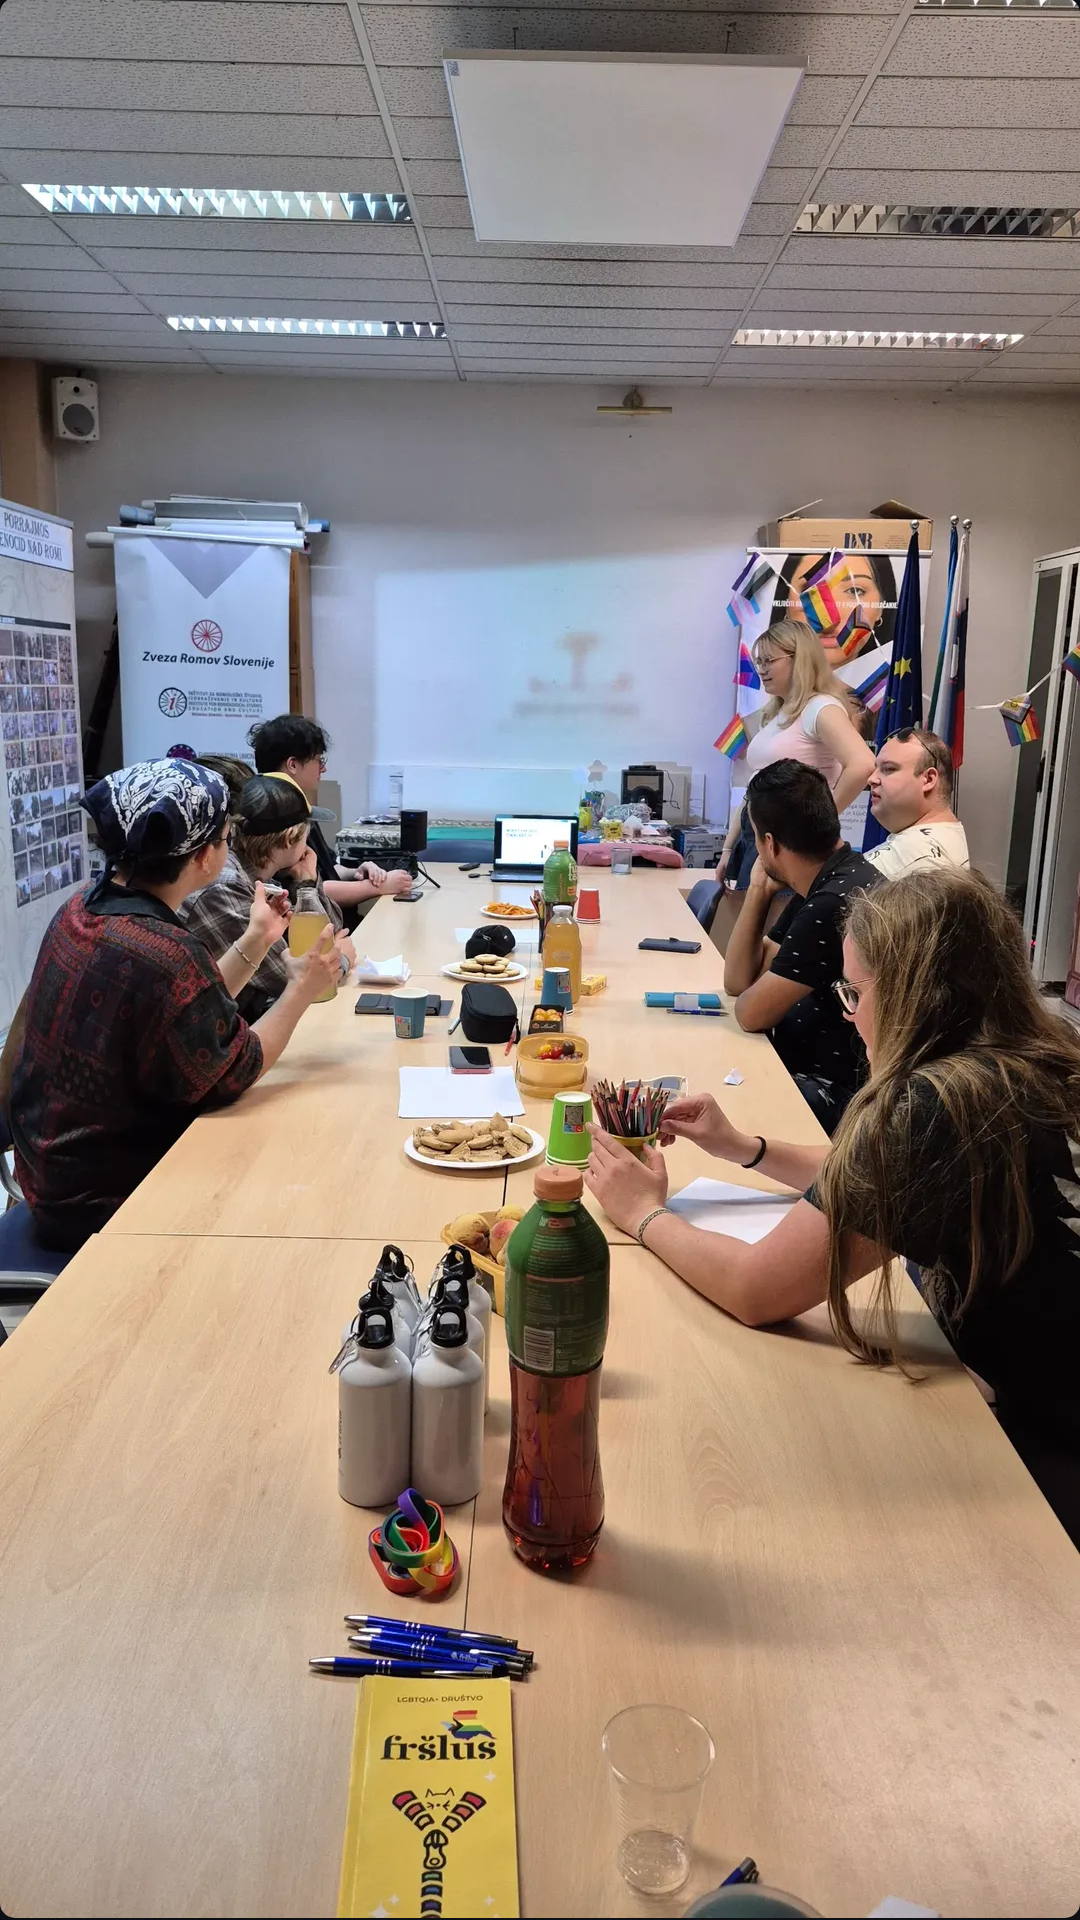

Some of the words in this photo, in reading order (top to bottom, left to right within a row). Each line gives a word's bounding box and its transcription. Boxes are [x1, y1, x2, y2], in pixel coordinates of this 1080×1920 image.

[27, 539, 43, 556] NAD
[142, 651, 177, 662] Zveza
[180, 653, 221, 665] Romov
[223, 655, 275, 669] Slovenije
[441, 1694, 484, 1702] DRUŠTVO
[380, 1734, 497, 1760] fršlus
